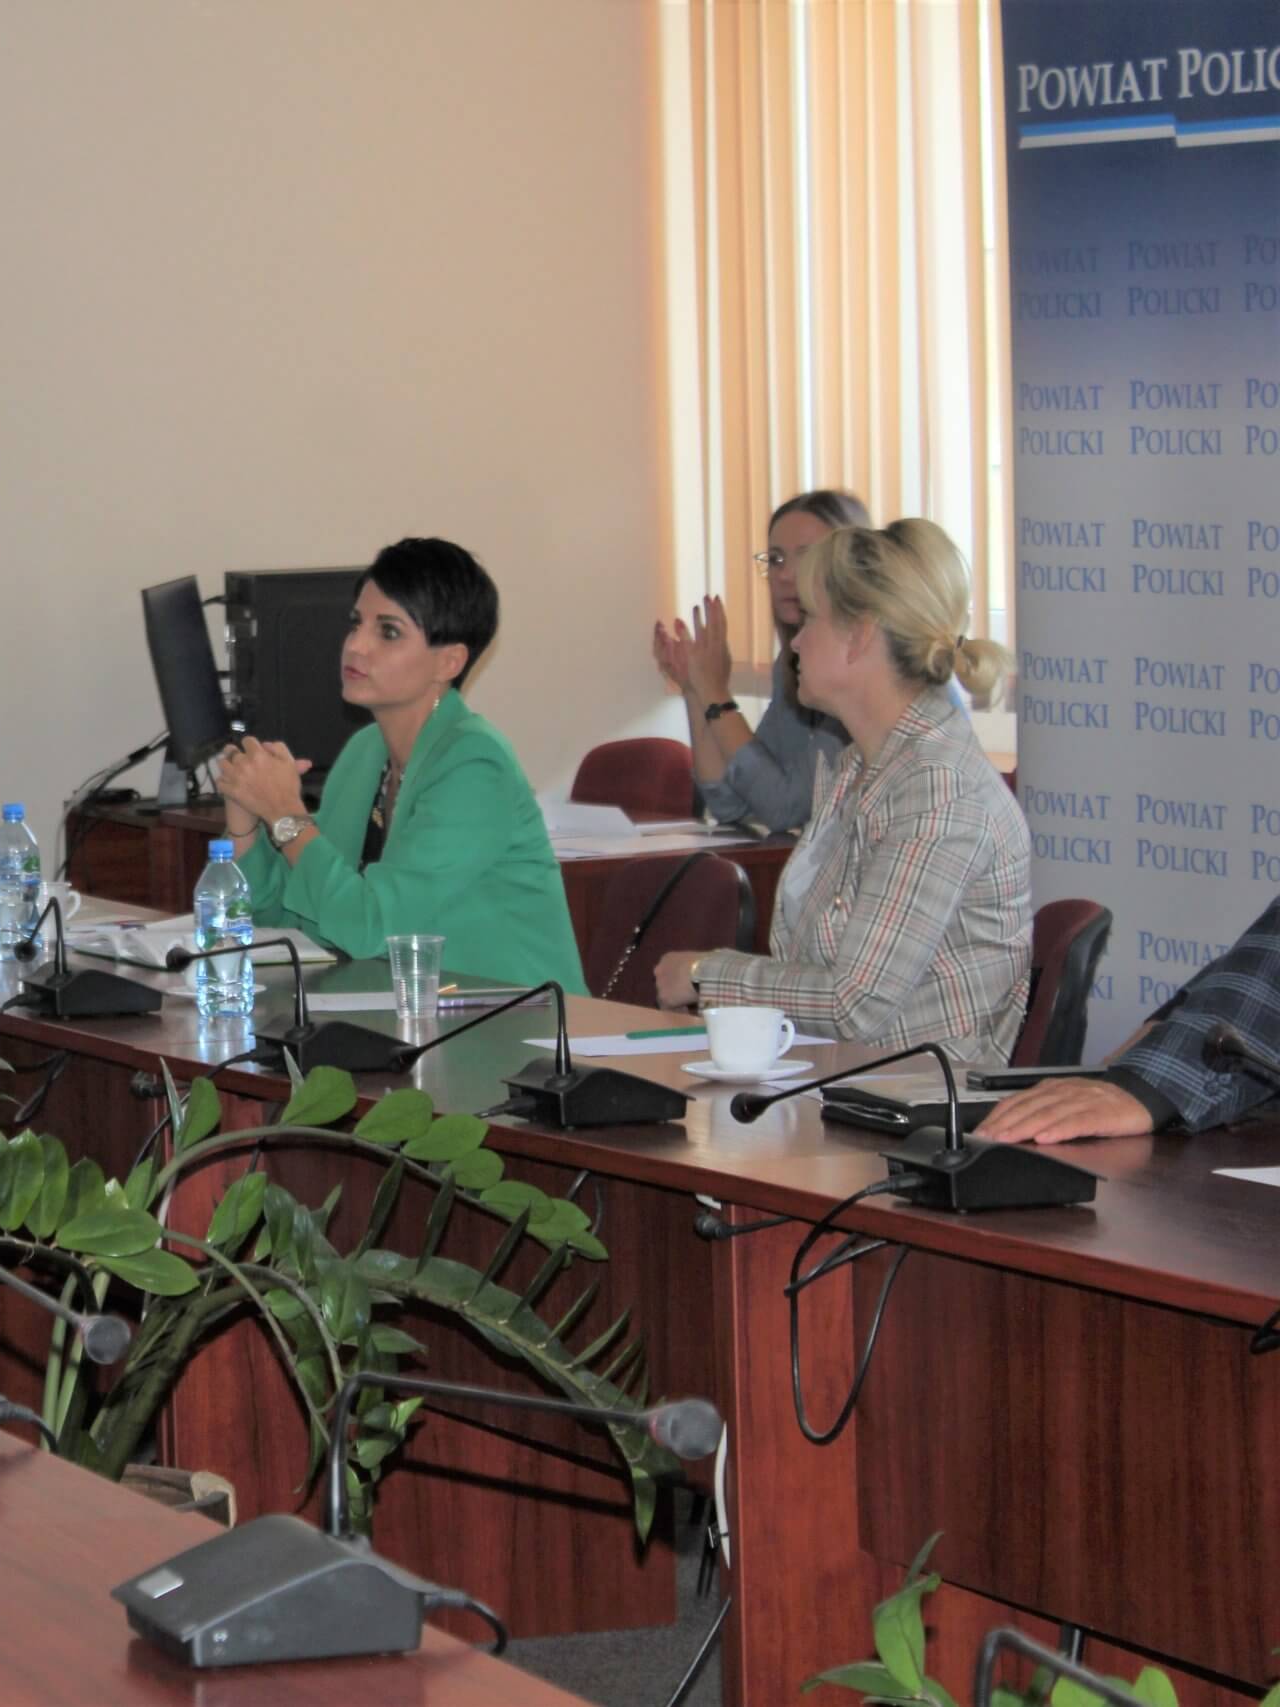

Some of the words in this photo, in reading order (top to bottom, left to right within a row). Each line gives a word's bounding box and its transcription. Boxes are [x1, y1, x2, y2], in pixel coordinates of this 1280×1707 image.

[1018, 58, 1168, 112] POWIAT
[1128, 240, 1219, 271] POWIAT
[1017, 291, 1103, 321] POLICKI
[1128, 285, 1221, 317] POLICKI
[1019, 381, 1105, 411] POWIAT
[1129, 379, 1223, 411] POWIAT
[1019, 426, 1105, 456] POLICKI
[1129, 425, 1223, 456] POLICKI
[1021, 517, 1106, 548] POWIAT
[1132, 518, 1224, 550] POWIAT
[1021, 561, 1106, 593] POLICKI
[1132, 564, 1225, 597] POLICKI
[1022, 651, 1109, 685] POWIAT
[1134, 656, 1226, 691] POWIAT
[1022, 695, 1110, 729] POLICKI
[1134, 701, 1227, 737] POLICKI
[1023, 785, 1112, 820] POWIAT
[1136, 794, 1228, 831] POWIAT
[1031, 831, 1112, 865] OLICKI
[1136, 839, 1228, 878] POLICKI
